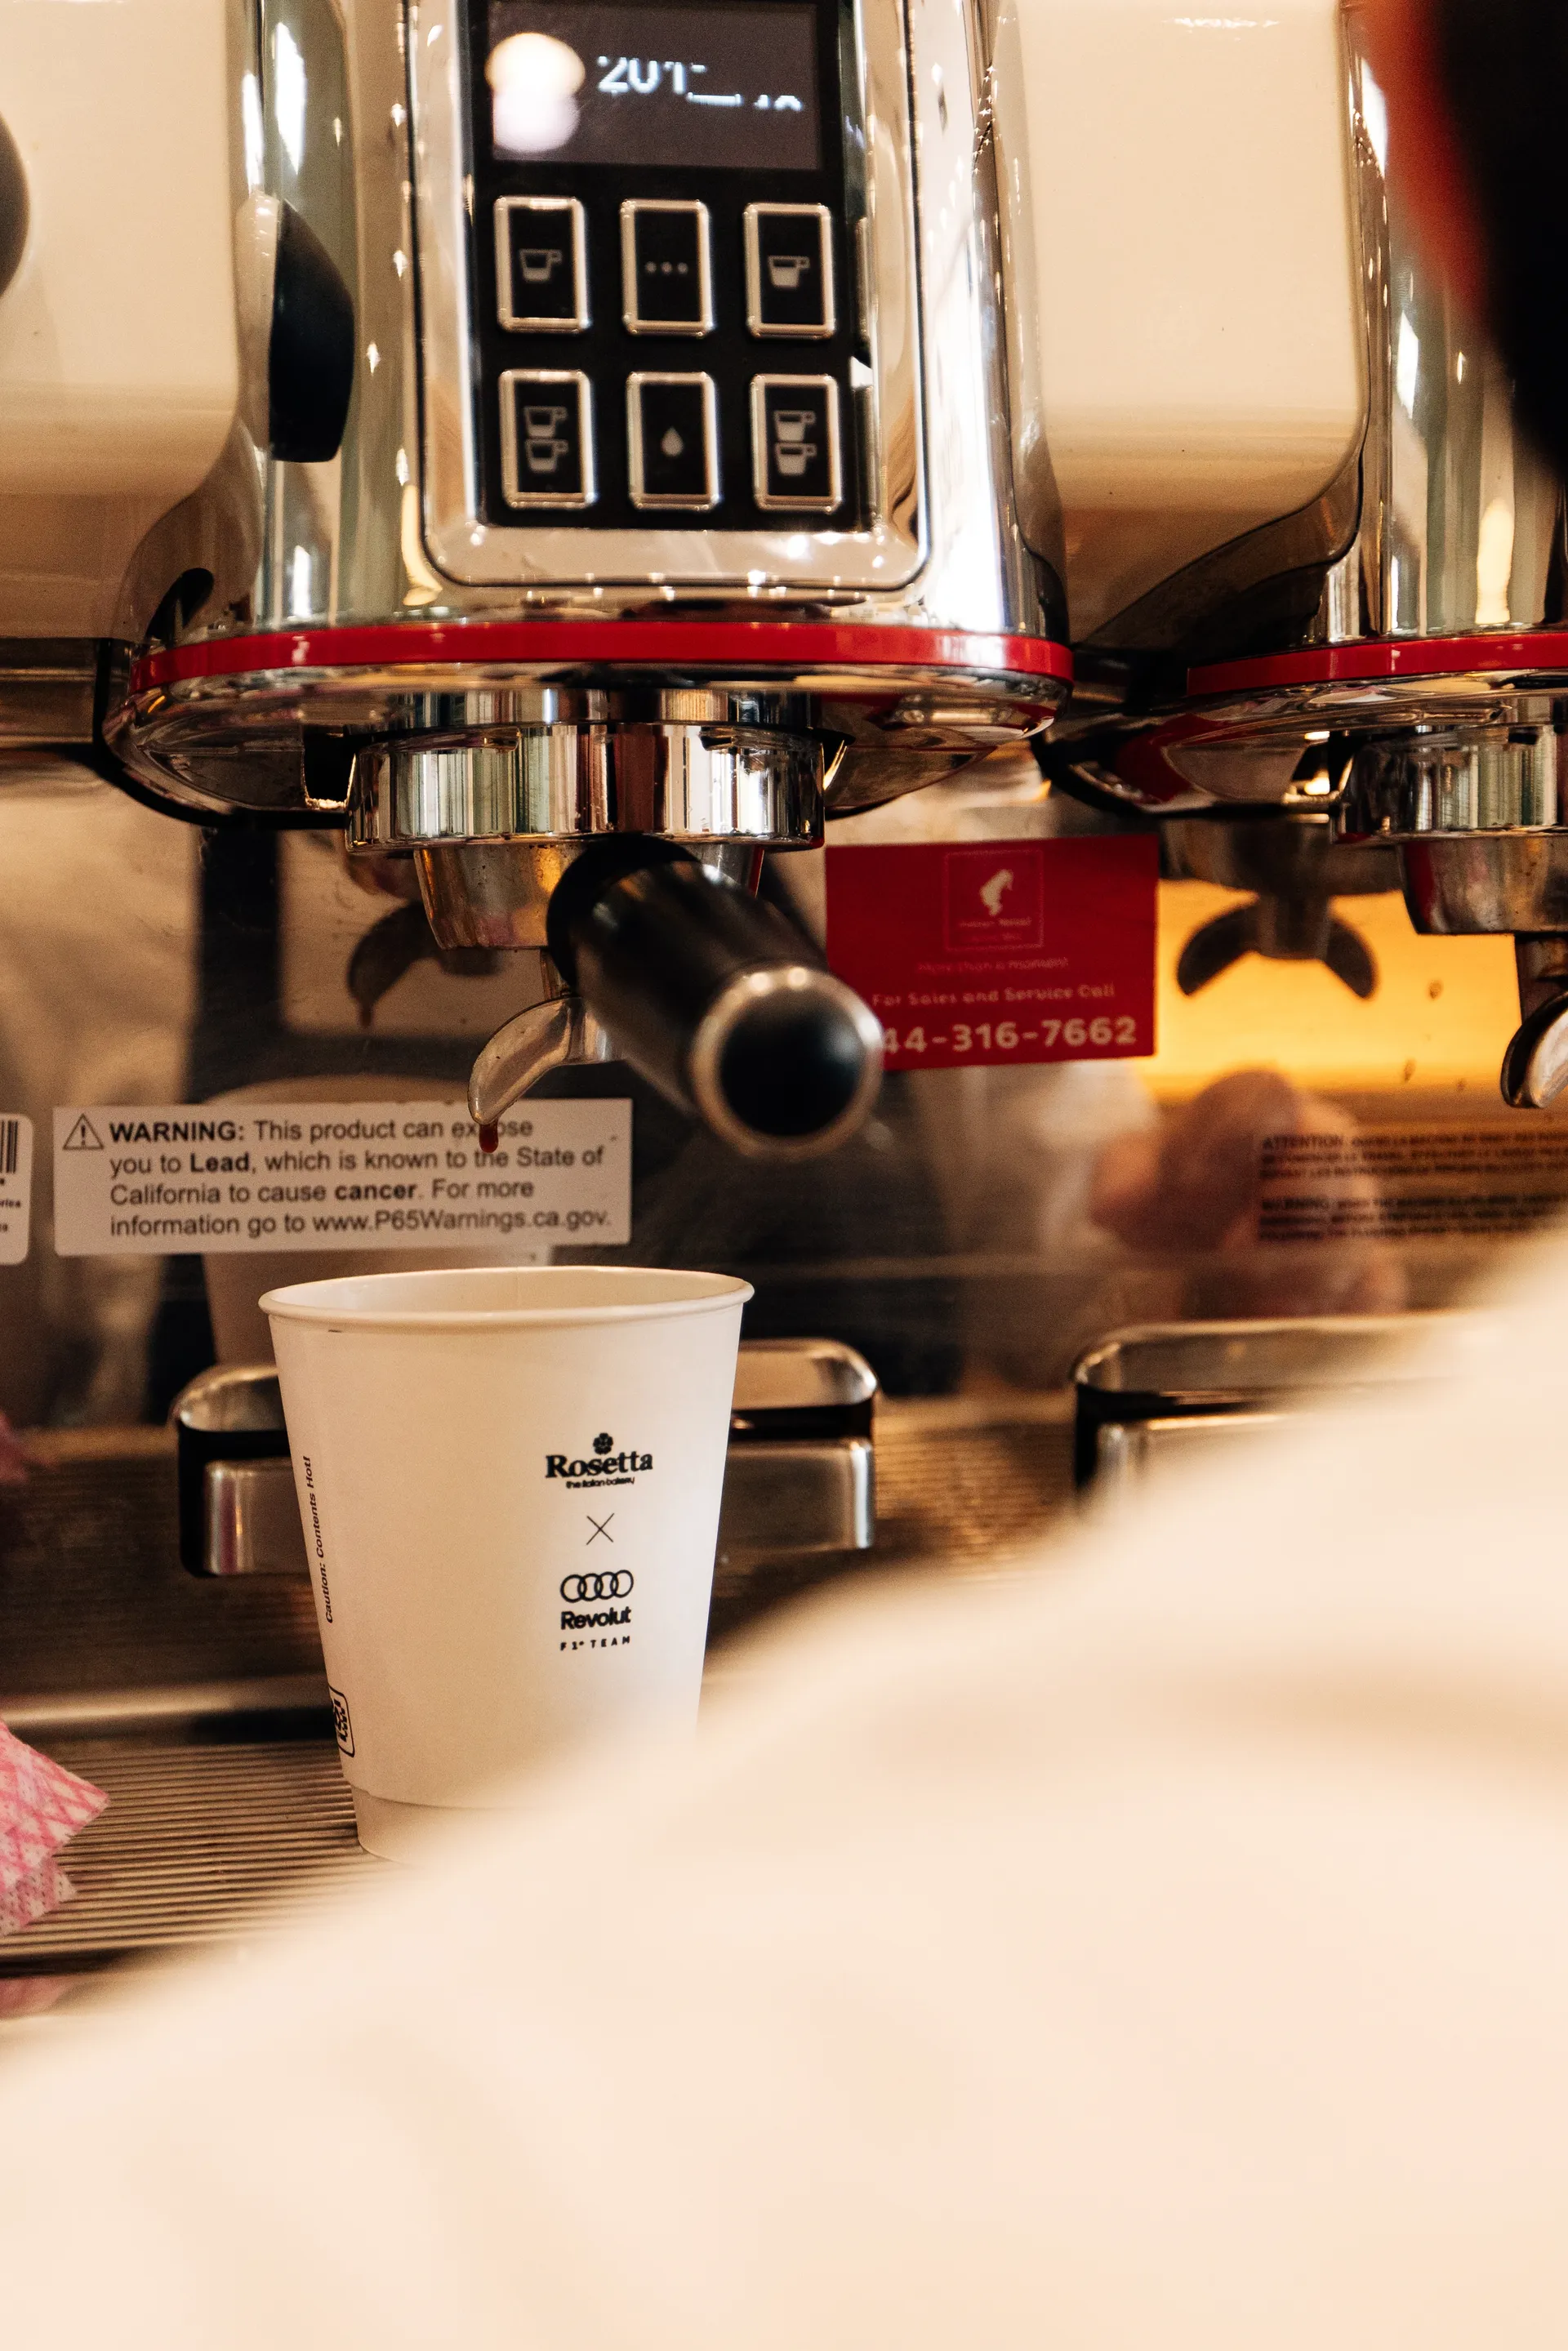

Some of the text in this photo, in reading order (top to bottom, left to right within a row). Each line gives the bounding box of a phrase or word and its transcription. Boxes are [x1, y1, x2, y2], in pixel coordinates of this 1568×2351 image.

[872, 982, 1116, 1006] For Sales and Service Call
[883, 1015, 1138, 1054] 44-316-7662
[109, 1120, 244, 1142] WARNING:
[254, 1119, 302, 1141] This
[310, 1119, 396, 1144] product
[403, 1120, 444, 1139] can
[109, 1144, 606, 1179] you to Lead, which is known to the State of
[110, 1178, 534, 1205] California to cause cancer. For more
[109, 1213, 240, 1236] information
[247, 1216, 276, 1239] go
[284, 1213, 305, 1233] to
[546, 1451, 653, 1478] Rosetta
[302, 1455, 333, 1624] Caution: Contents Hot!
[560, 1606, 631, 1630] Revolut
[590, 1636, 630, 1649] TEAM
